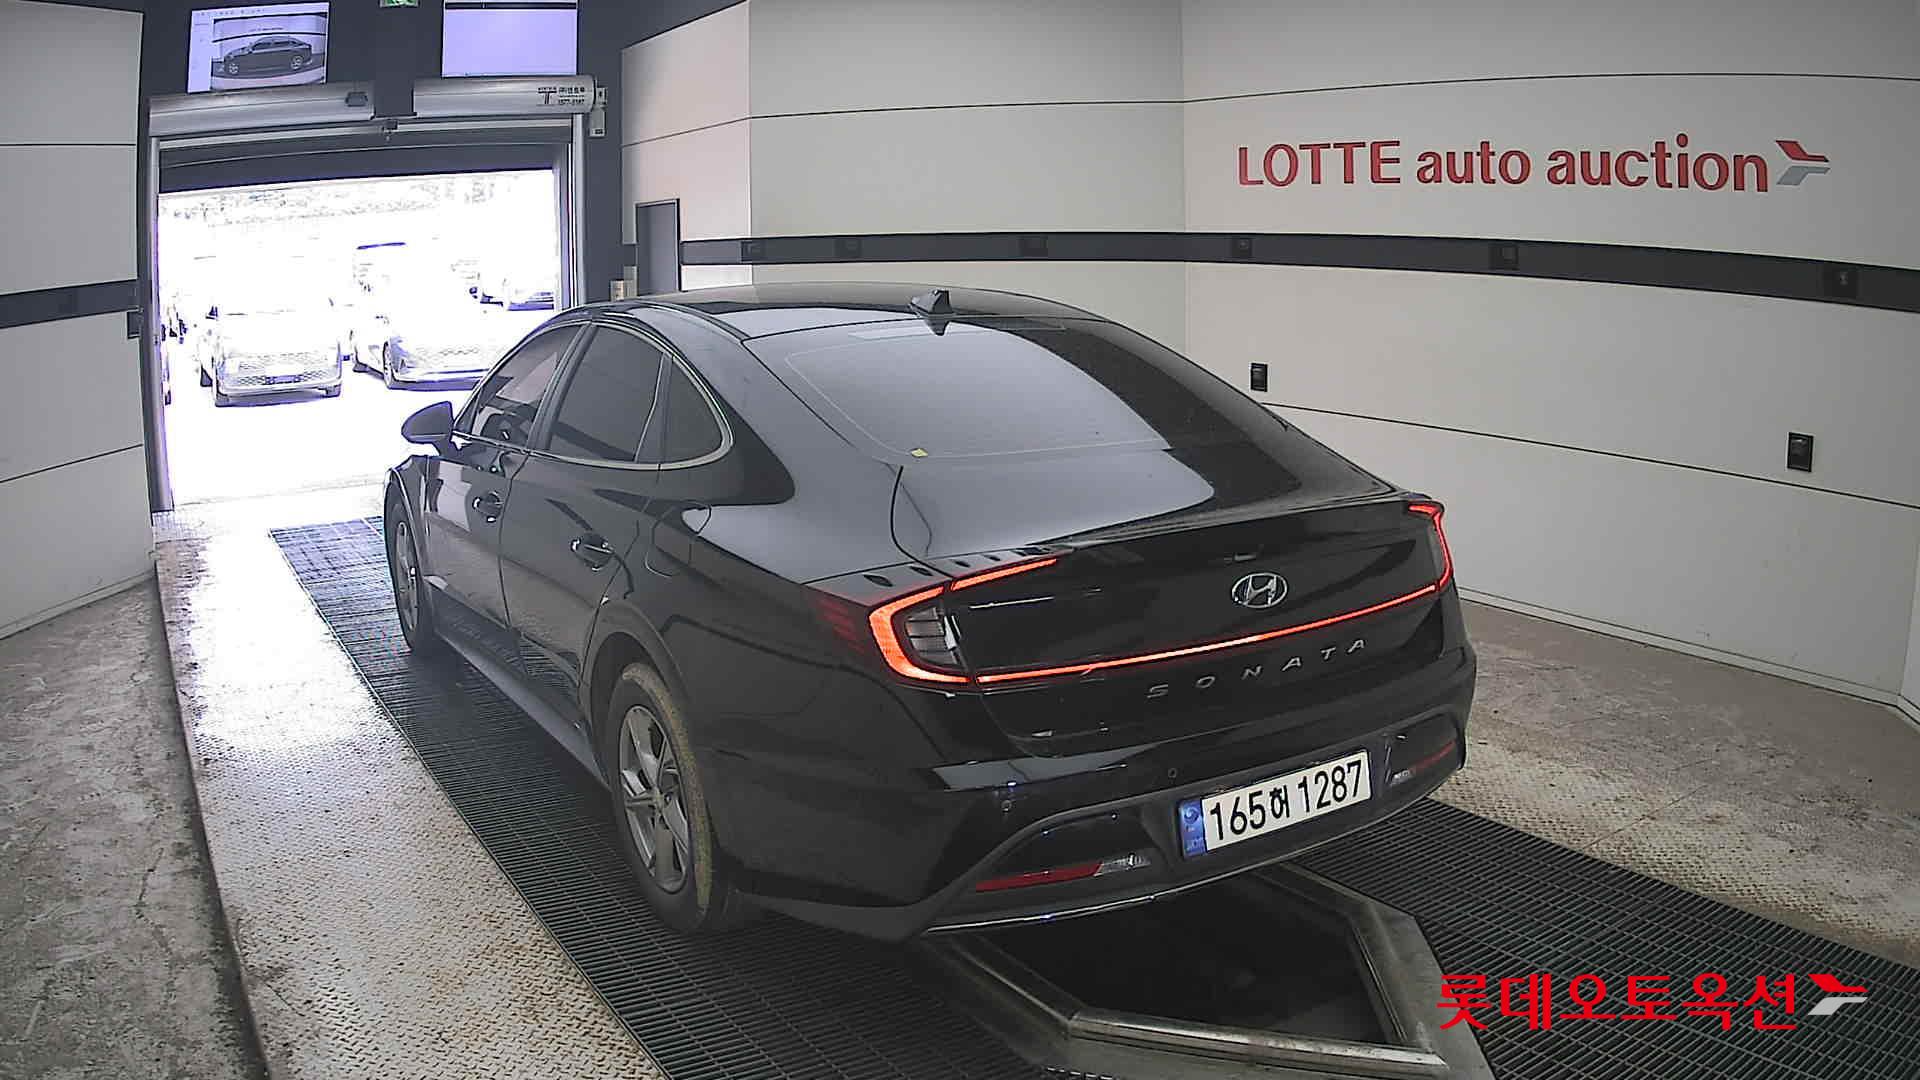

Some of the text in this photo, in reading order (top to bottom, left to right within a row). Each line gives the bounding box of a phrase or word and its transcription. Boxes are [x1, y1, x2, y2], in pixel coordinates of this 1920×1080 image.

[1238, 134, 1770, 193] LOTTE auto auction
[1146, 638, 1366, 699] SONATA
[1209, 759, 1363, 842] 165허 1287
